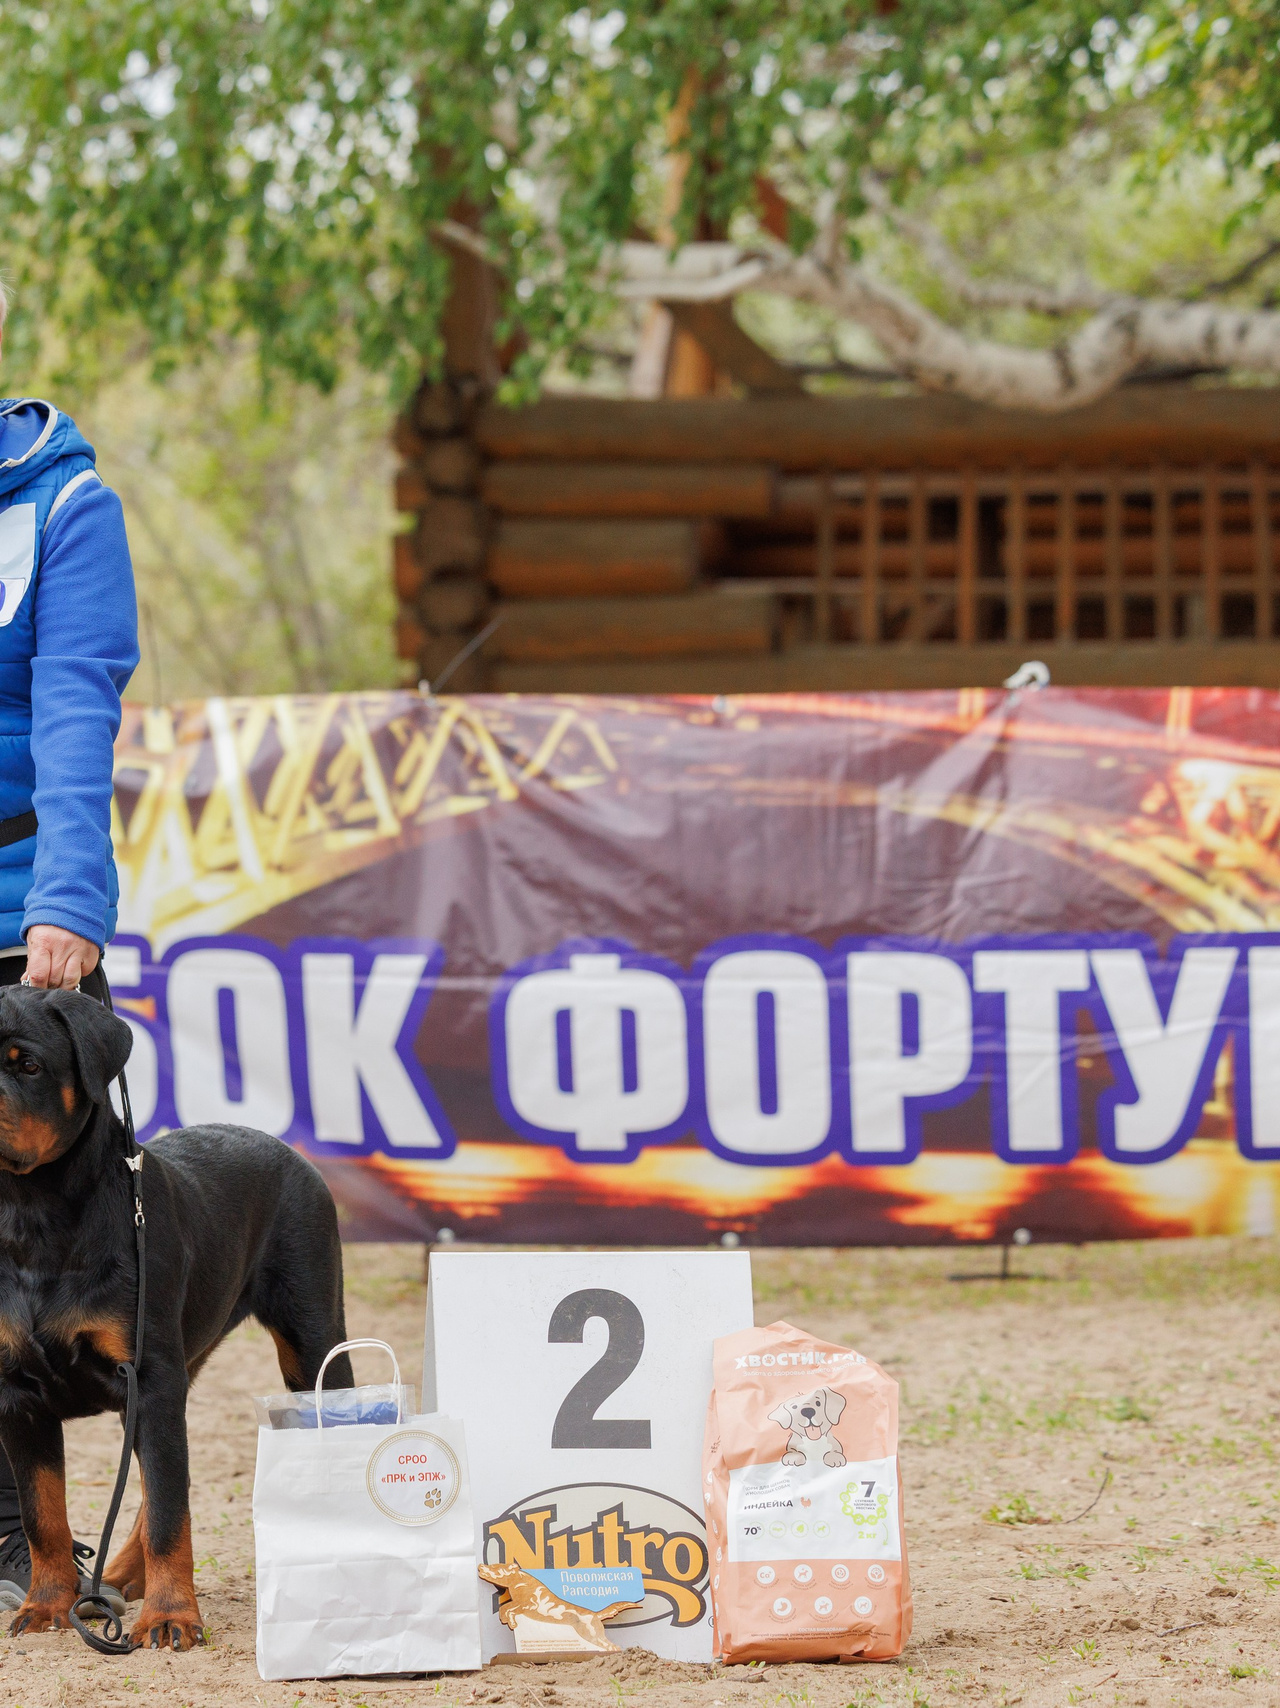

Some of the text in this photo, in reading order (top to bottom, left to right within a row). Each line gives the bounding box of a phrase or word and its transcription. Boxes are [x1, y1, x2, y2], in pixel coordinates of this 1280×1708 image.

[504, 947, 1280, 1154] ФОРТУ
[547, 1288, 652, 1449] 2
[397, 1454, 427, 1465] СРОО
[861, 1481, 876, 1498] 7
[483, 1502, 709, 1627] Nutro
[560, 1571, 634, 1583] Поволжская
[562, 1584, 619, 1597] Рапсодия
